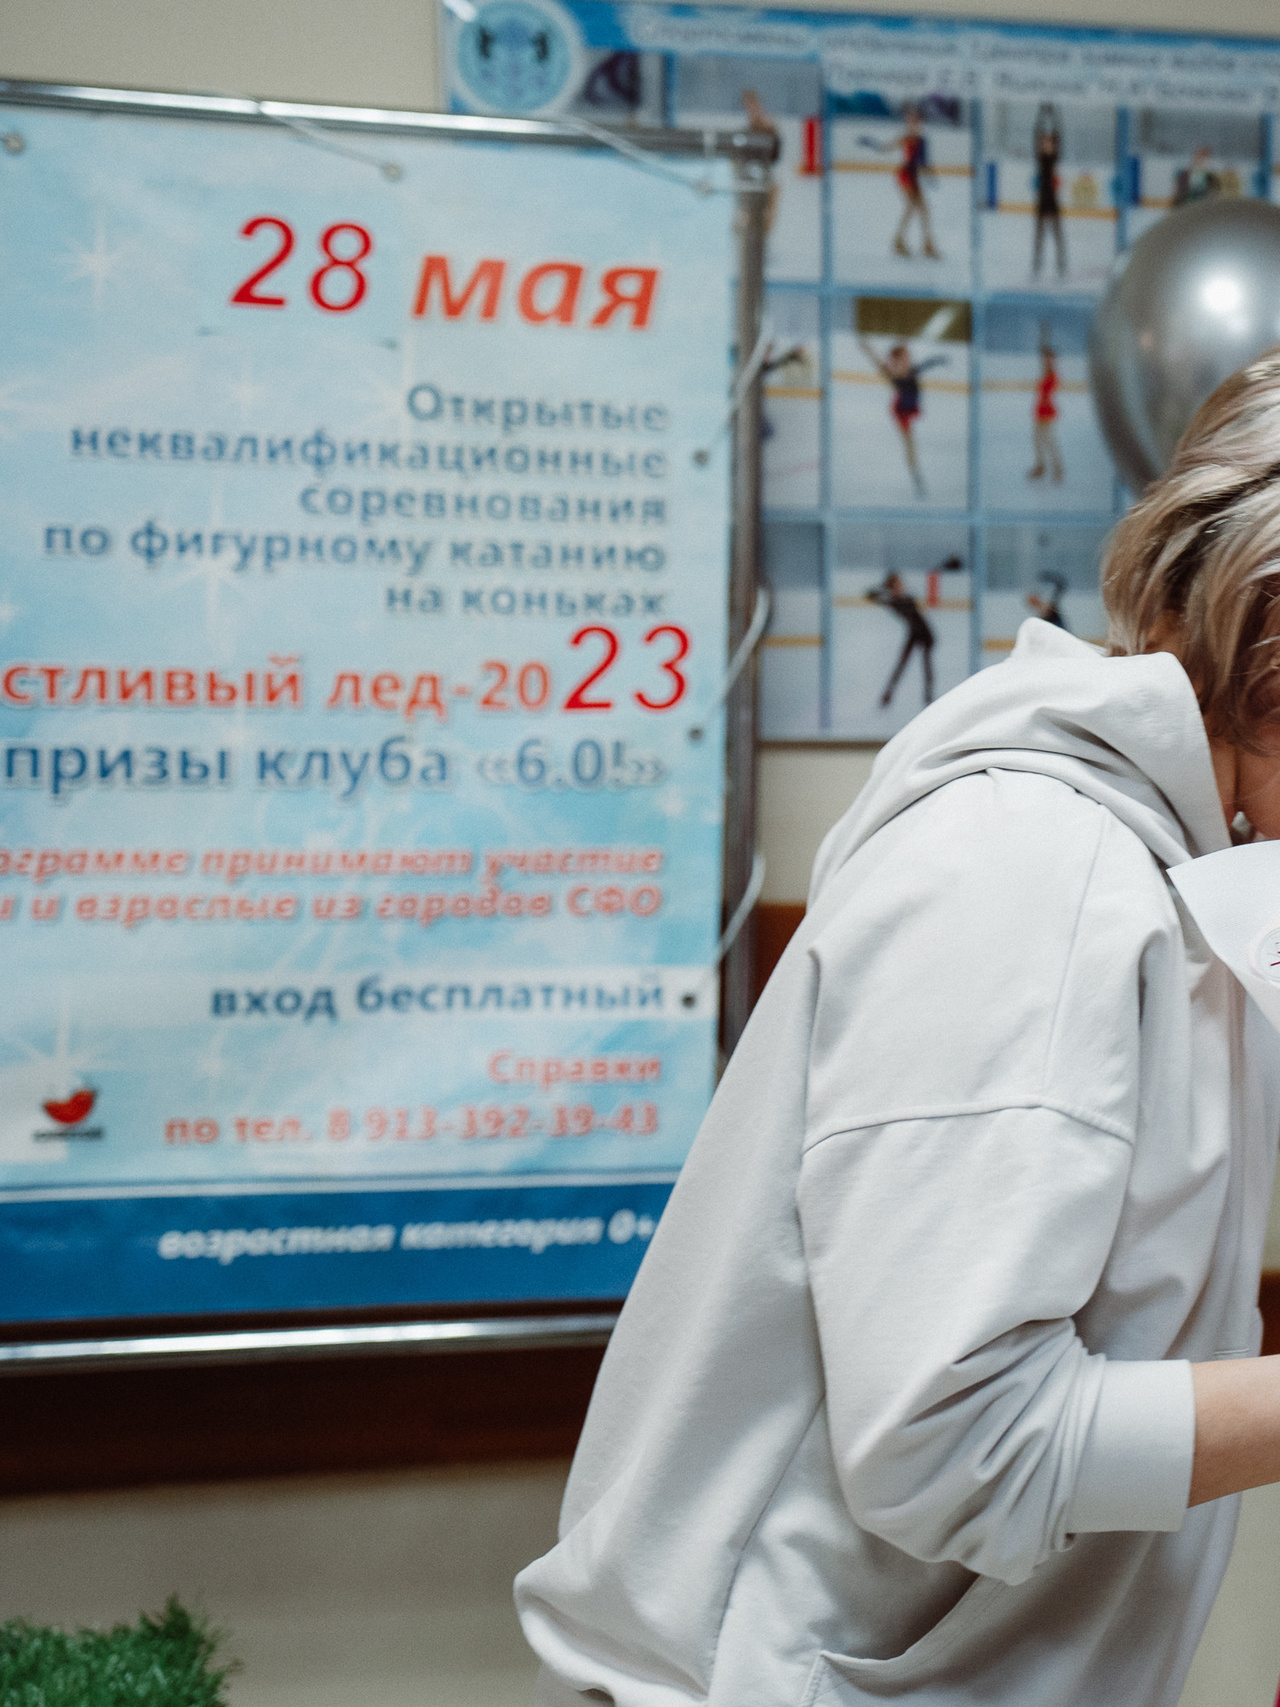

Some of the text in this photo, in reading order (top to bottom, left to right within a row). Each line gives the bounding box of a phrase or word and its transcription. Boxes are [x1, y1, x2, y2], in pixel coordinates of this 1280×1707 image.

[229, 214, 658, 330] 28 мая
[406, 383, 669, 437] Открытые
[70, 427, 669, 480] неквалификационные
[299, 486, 667, 528] соревнования
[44, 517, 667, 577] по фигурному катанию
[386, 586, 664, 617] на коньках
[4, 747, 229, 797] призы
[257, 733, 450, 797] клуба
[202, 848, 474, 885] принимают
[478, 846, 665, 897] участие
[30, 893, 60, 921] и
[75, 893, 301, 929] взрослые
[312, 892, 364, 921] из
[374, 888, 553, 927] городов
[567, 884, 664, 918] СФО
[210, 972, 665, 1023] вход бесплатный
[488, 1050, 662, 1089] Справки
[164, 1117, 219, 1144] по
[233, 1114, 313, 1143] тел.
[327, 1106, 352, 1141] 8
[157, 1223, 398, 1265] возрастная
[401, 1216, 602, 1254] категория
